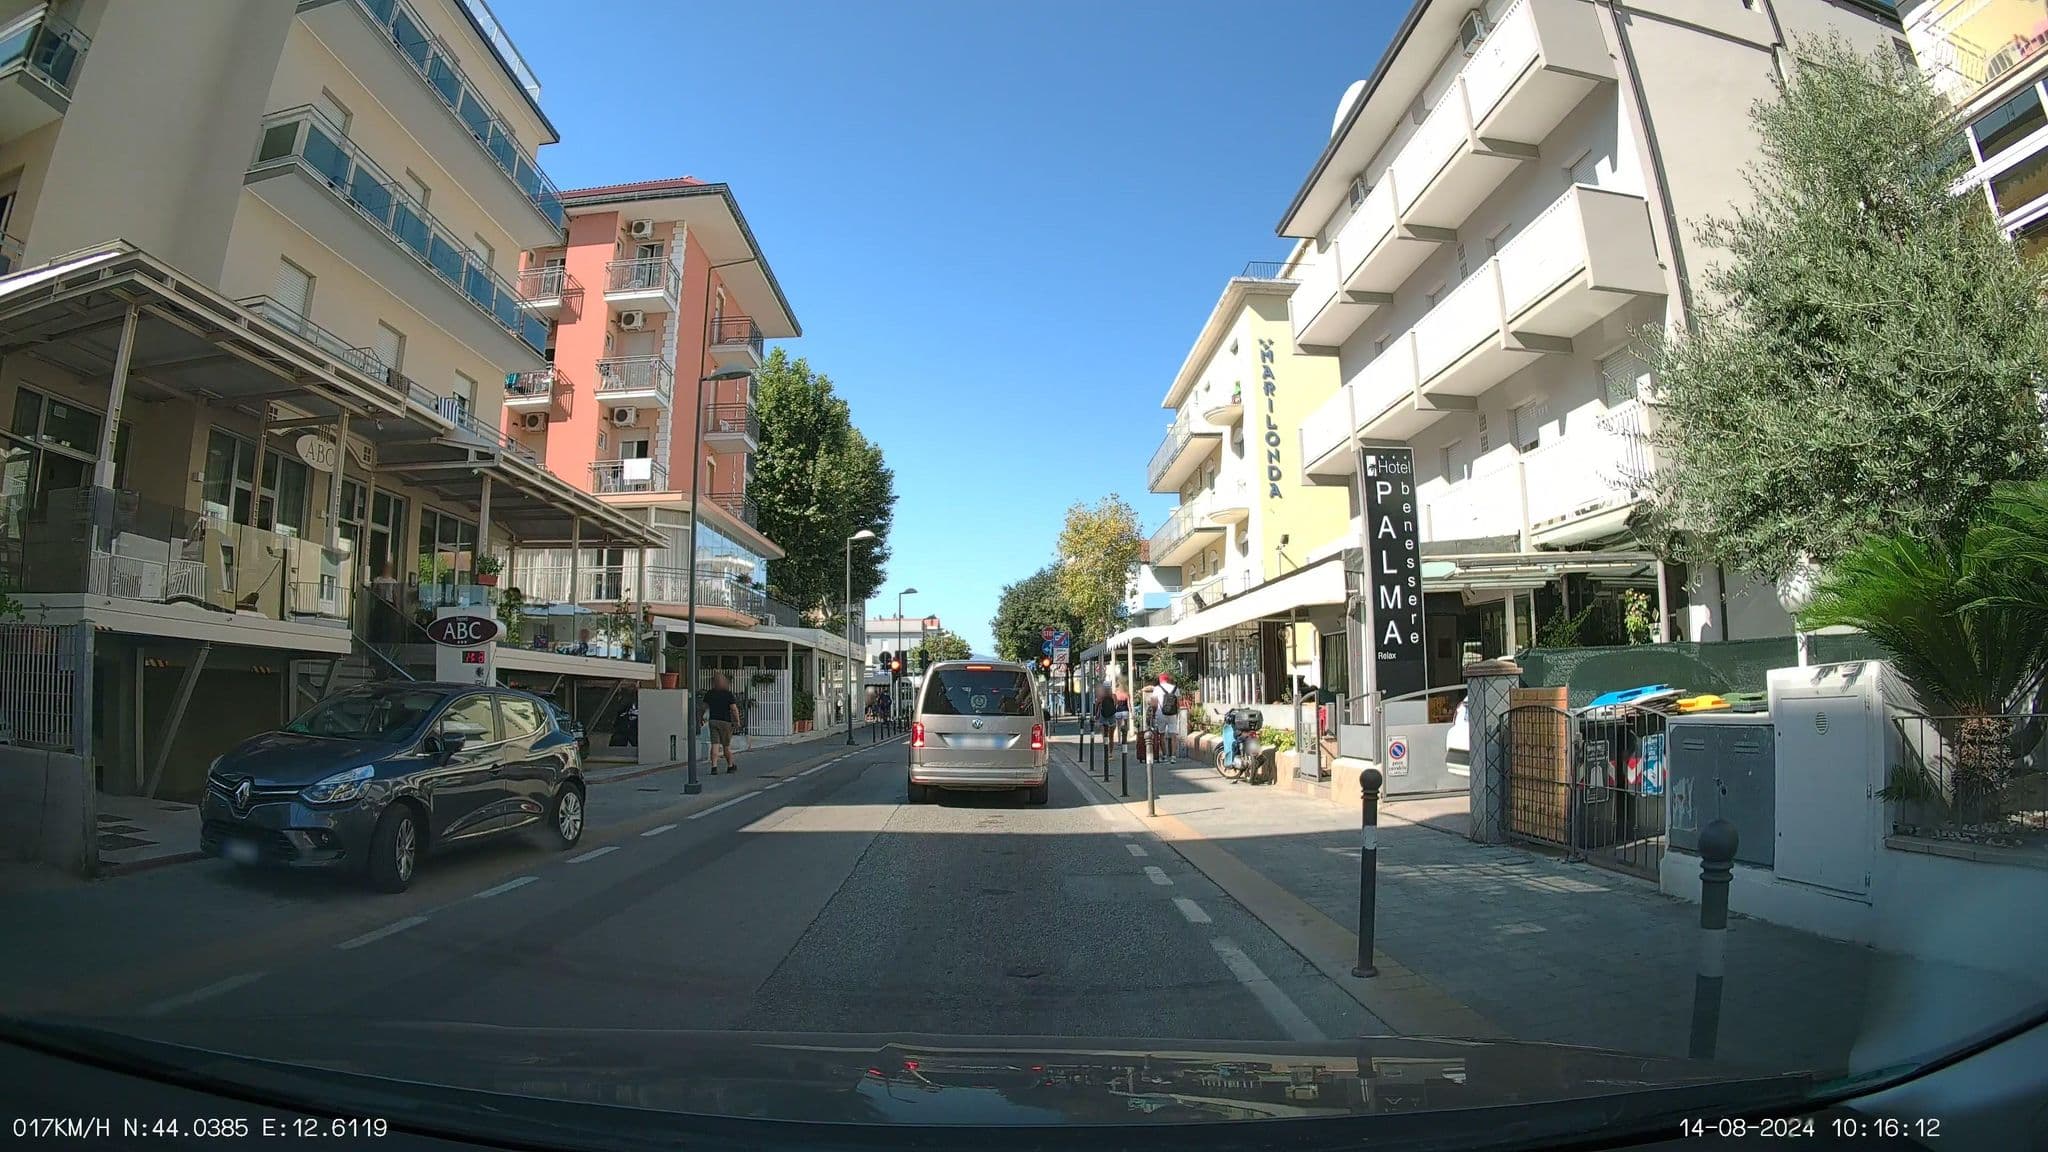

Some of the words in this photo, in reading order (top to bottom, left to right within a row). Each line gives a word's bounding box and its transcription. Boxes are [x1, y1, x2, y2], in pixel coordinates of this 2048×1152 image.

[1259, 349, 1283, 499] MARILONDA
[304, 440, 335, 467] ABC
[1378, 460, 1411, 474] Hotel
[1376, 481, 1402, 645] PALMA
[1400, 481, 1419, 643] benessere
[442, 621, 481, 640] ABC
[1378, 651, 1397, 660] Relax
